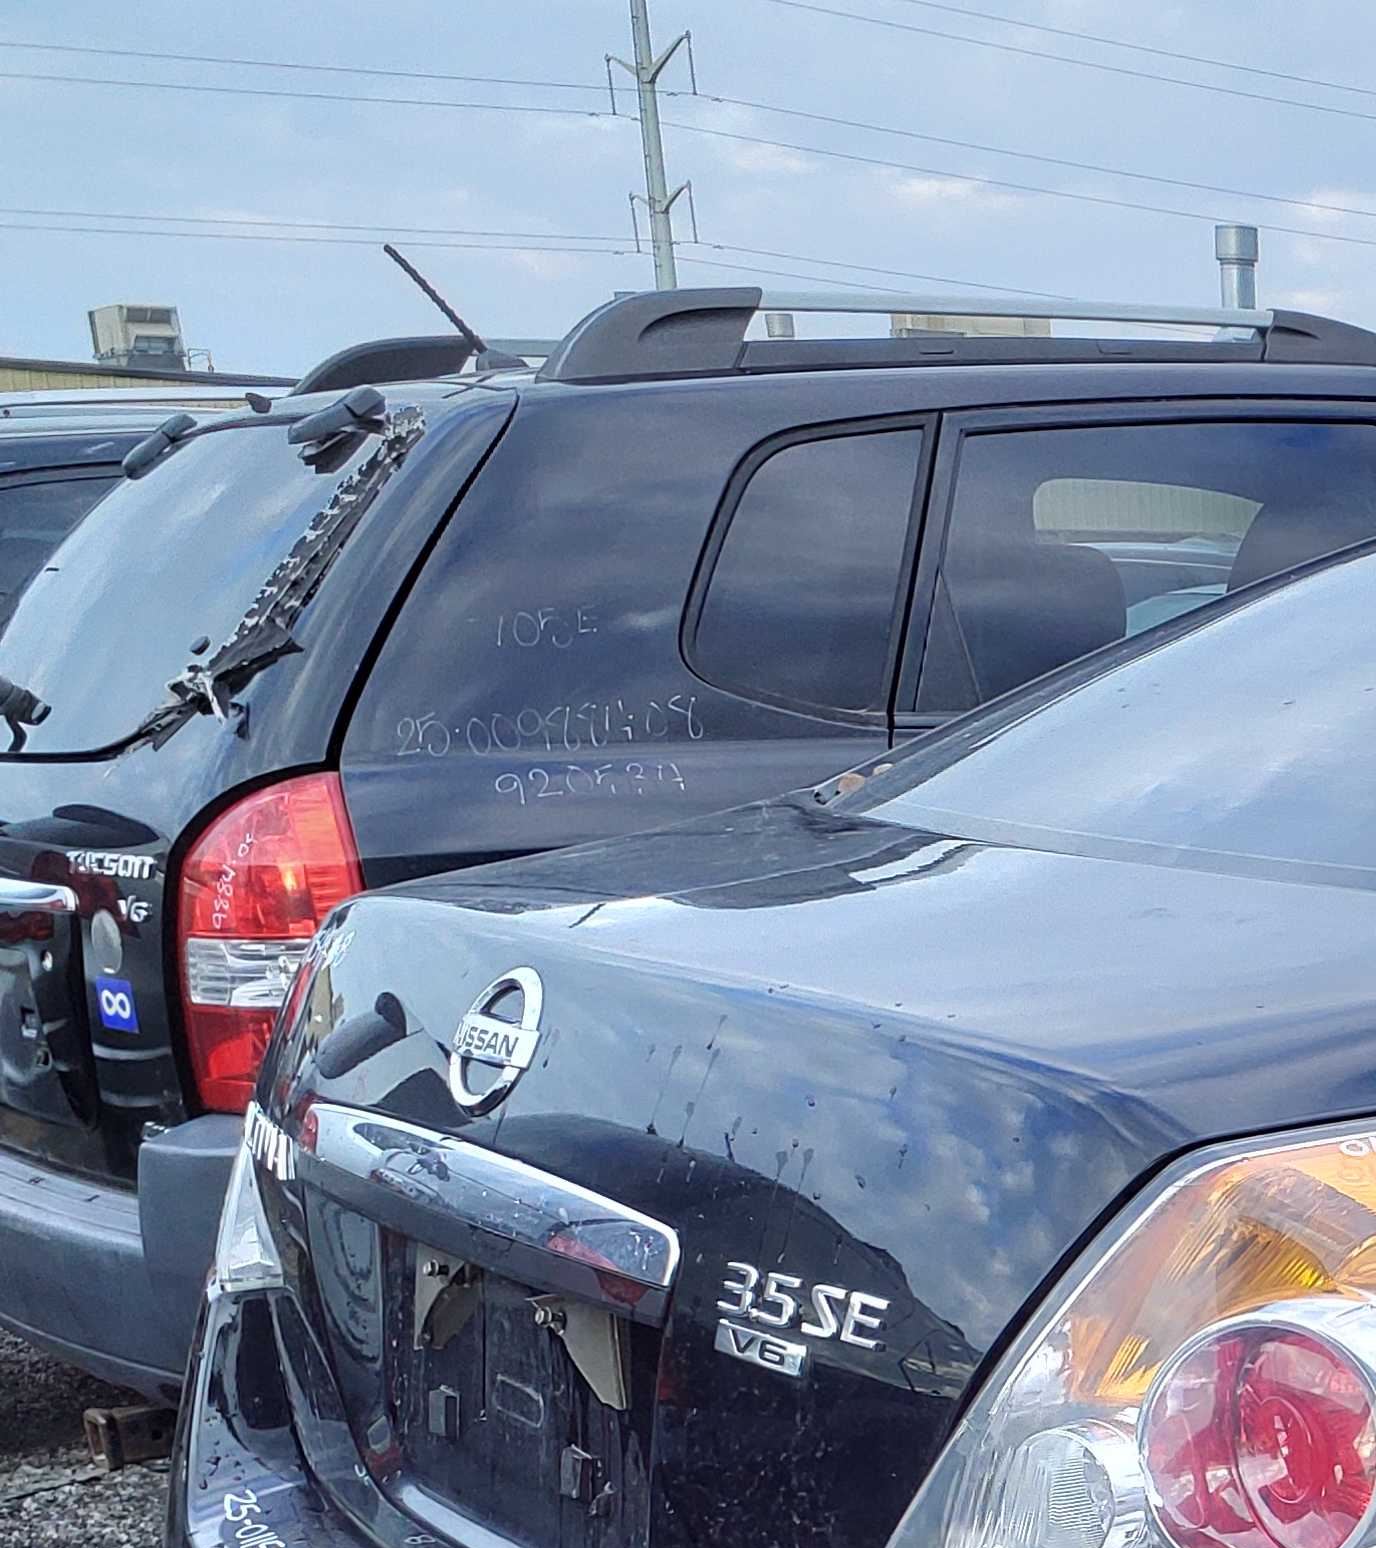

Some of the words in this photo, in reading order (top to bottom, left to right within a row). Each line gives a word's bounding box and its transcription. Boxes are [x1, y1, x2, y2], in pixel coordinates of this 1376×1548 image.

[66, 851, 158, 879] TUCSON
[117, 895, 152, 922] V6
[455, 1021, 520, 1059] NISSAN
[728, 1326, 786, 1366] V6
